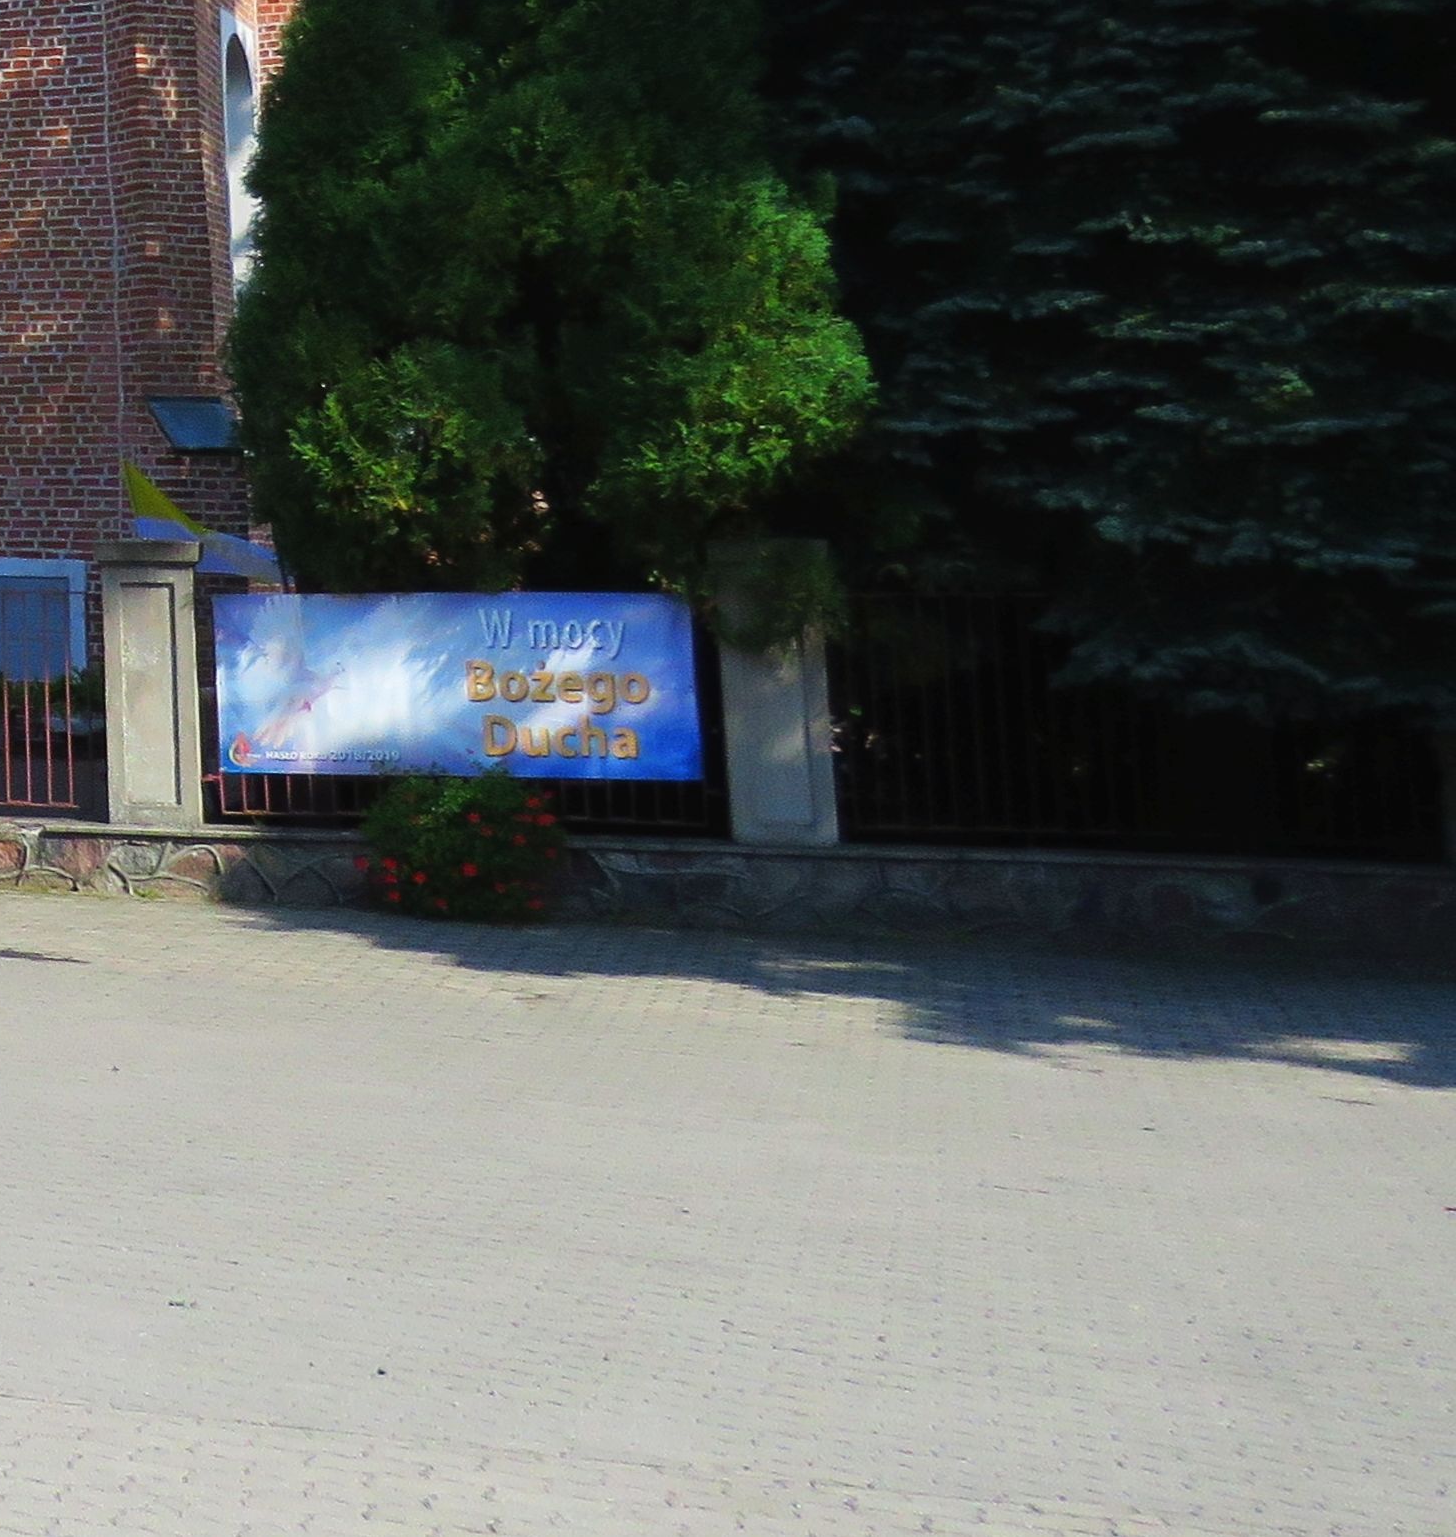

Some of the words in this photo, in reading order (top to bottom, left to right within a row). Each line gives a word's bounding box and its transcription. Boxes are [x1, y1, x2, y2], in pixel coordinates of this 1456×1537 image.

[477, 607, 513, 650] W
[527, 619, 626, 660] mocy
[465, 659, 651, 715] Bożego
[482, 713, 640, 760] Ducha
